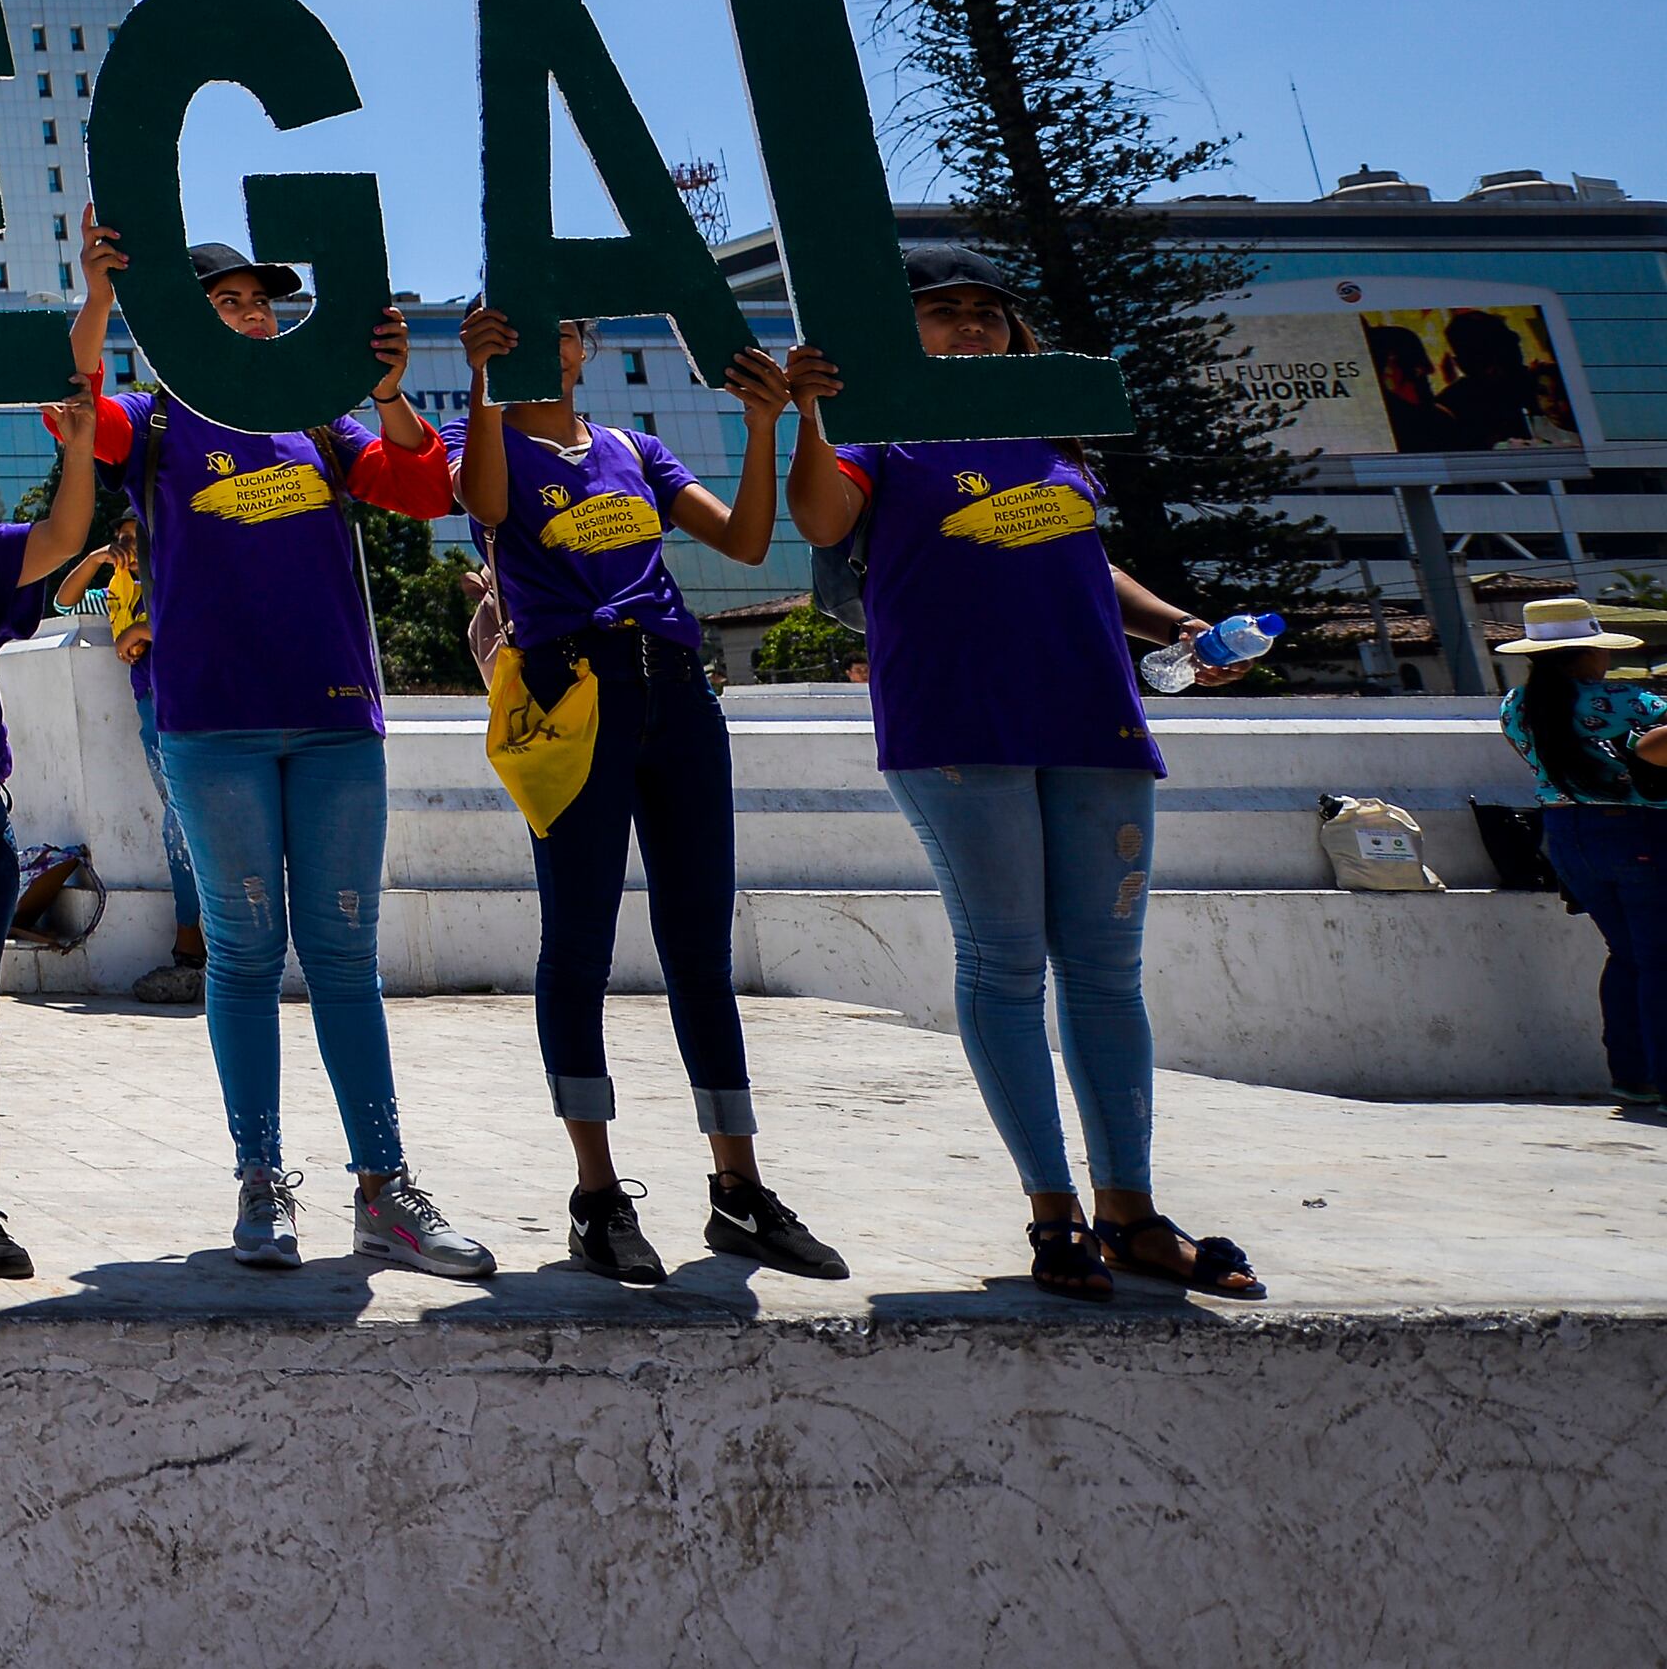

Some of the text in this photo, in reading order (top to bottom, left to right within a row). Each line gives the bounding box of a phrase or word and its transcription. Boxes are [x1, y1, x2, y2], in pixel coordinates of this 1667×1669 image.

[1236, 362, 1327, 381] FUTURO
[1333, 361, 1360, 378] ES
[1236, 380, 1351, 401] AHORRA
[234, 468, 299, 487] LUCHAMOS
[237, 481, 301, 500] RESISTIMOS
[991, 488, 1057, 507] LUCHAMOS
[236, 493, 307, 512] AVANZAMOS
[571, 498, 630, 518] LUCHAMOS
[994, 502, 1061, 522] RESISTIMOS
[575, 511, 634, 531] RESISTIMOS
[994, 515, 1069, 535] AVANZAMOS
